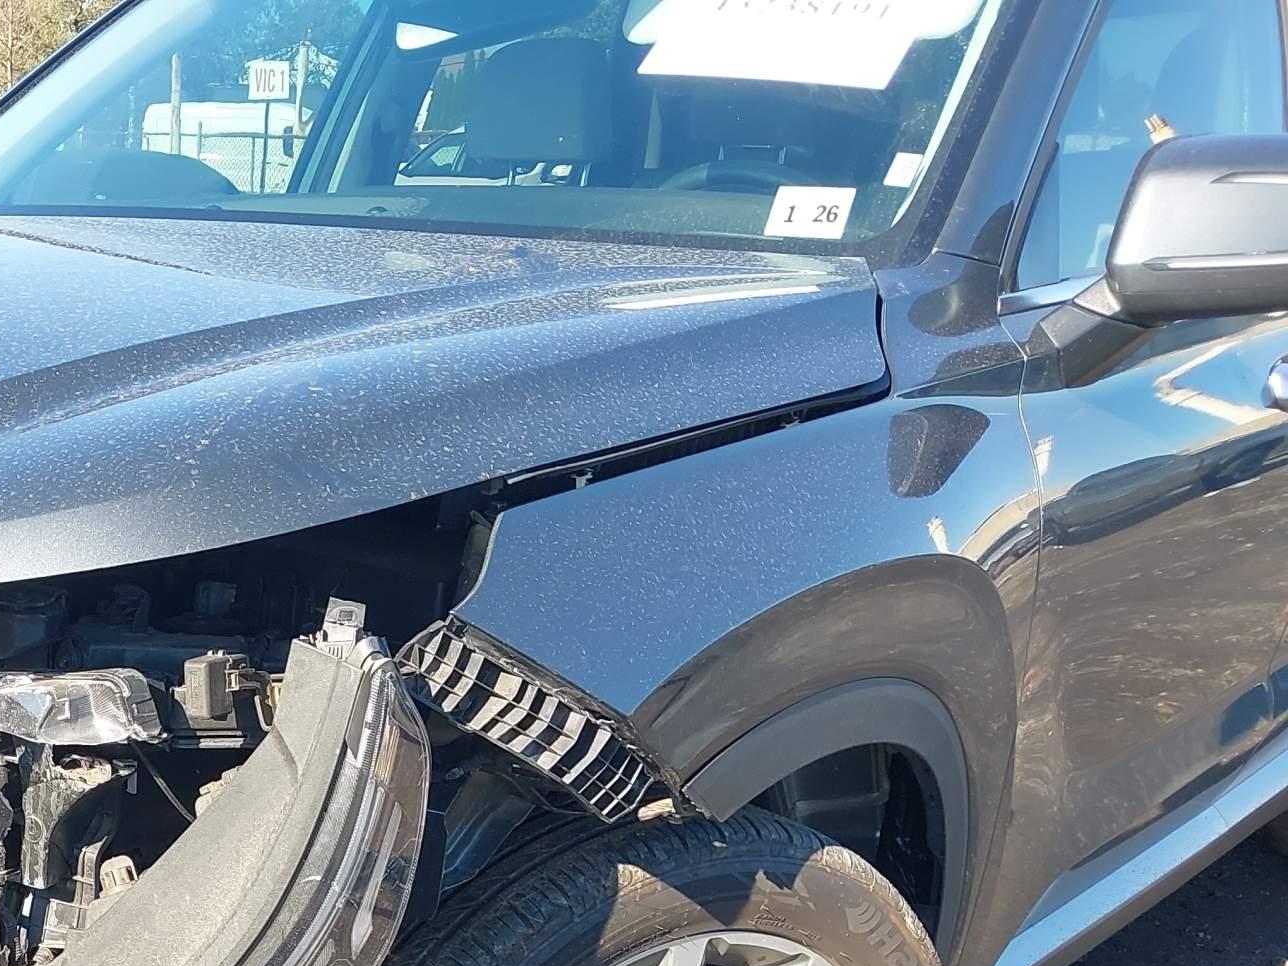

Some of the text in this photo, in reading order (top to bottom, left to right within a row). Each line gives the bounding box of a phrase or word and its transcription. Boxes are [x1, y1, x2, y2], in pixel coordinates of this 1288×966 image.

[255, 68, 286, 93] VIC 1
[783, 204, 840, 223] 1 26
